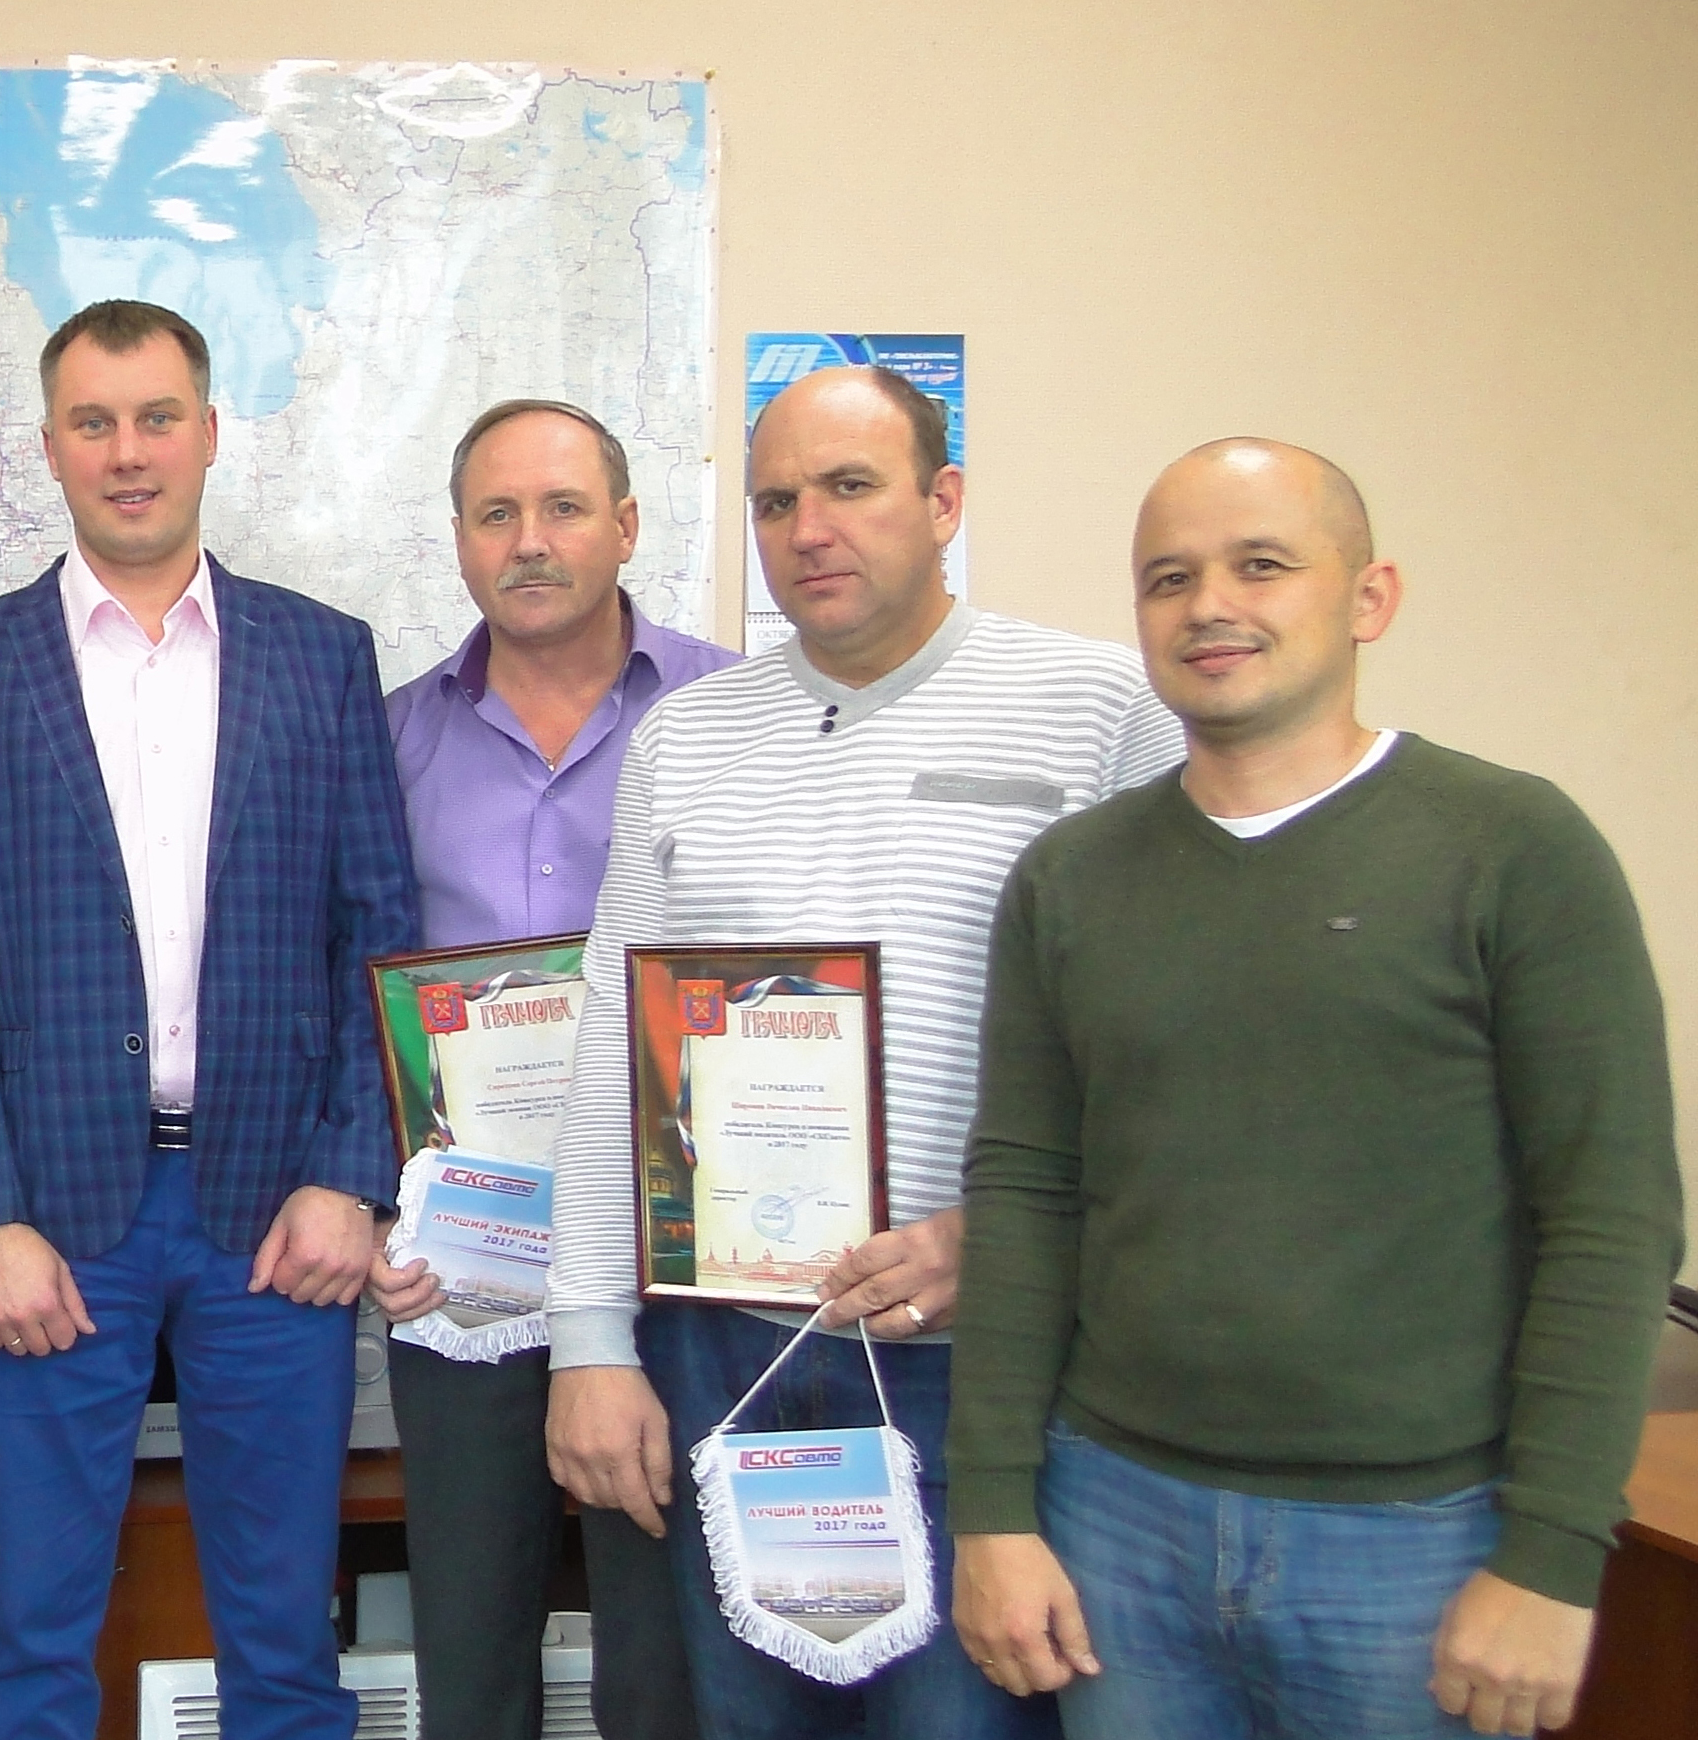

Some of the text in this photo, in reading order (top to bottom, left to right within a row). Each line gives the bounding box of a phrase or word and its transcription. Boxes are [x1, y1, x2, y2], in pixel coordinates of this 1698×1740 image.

[480, 997, 575, 1029] ГРАМОТА
[741, 1010, 842, 1039] ГРАМОТА
[495, 1060, 564, 1073] НАГРАЖДАЕТСЯ
[750, 1083, 825, 1092] НАГРАЖДАЕТСЯ
[433, 1213, 552, 1242] ЛУЧШИЙ ЭКИПАЖ
[483, 1235, 548, 1254] 2017 года
[748, 1503, 884, 1518] ЛУЧШИЙ ВОДИТЕЛЬ
[814, 1520, 887, 1531] 2017 года
